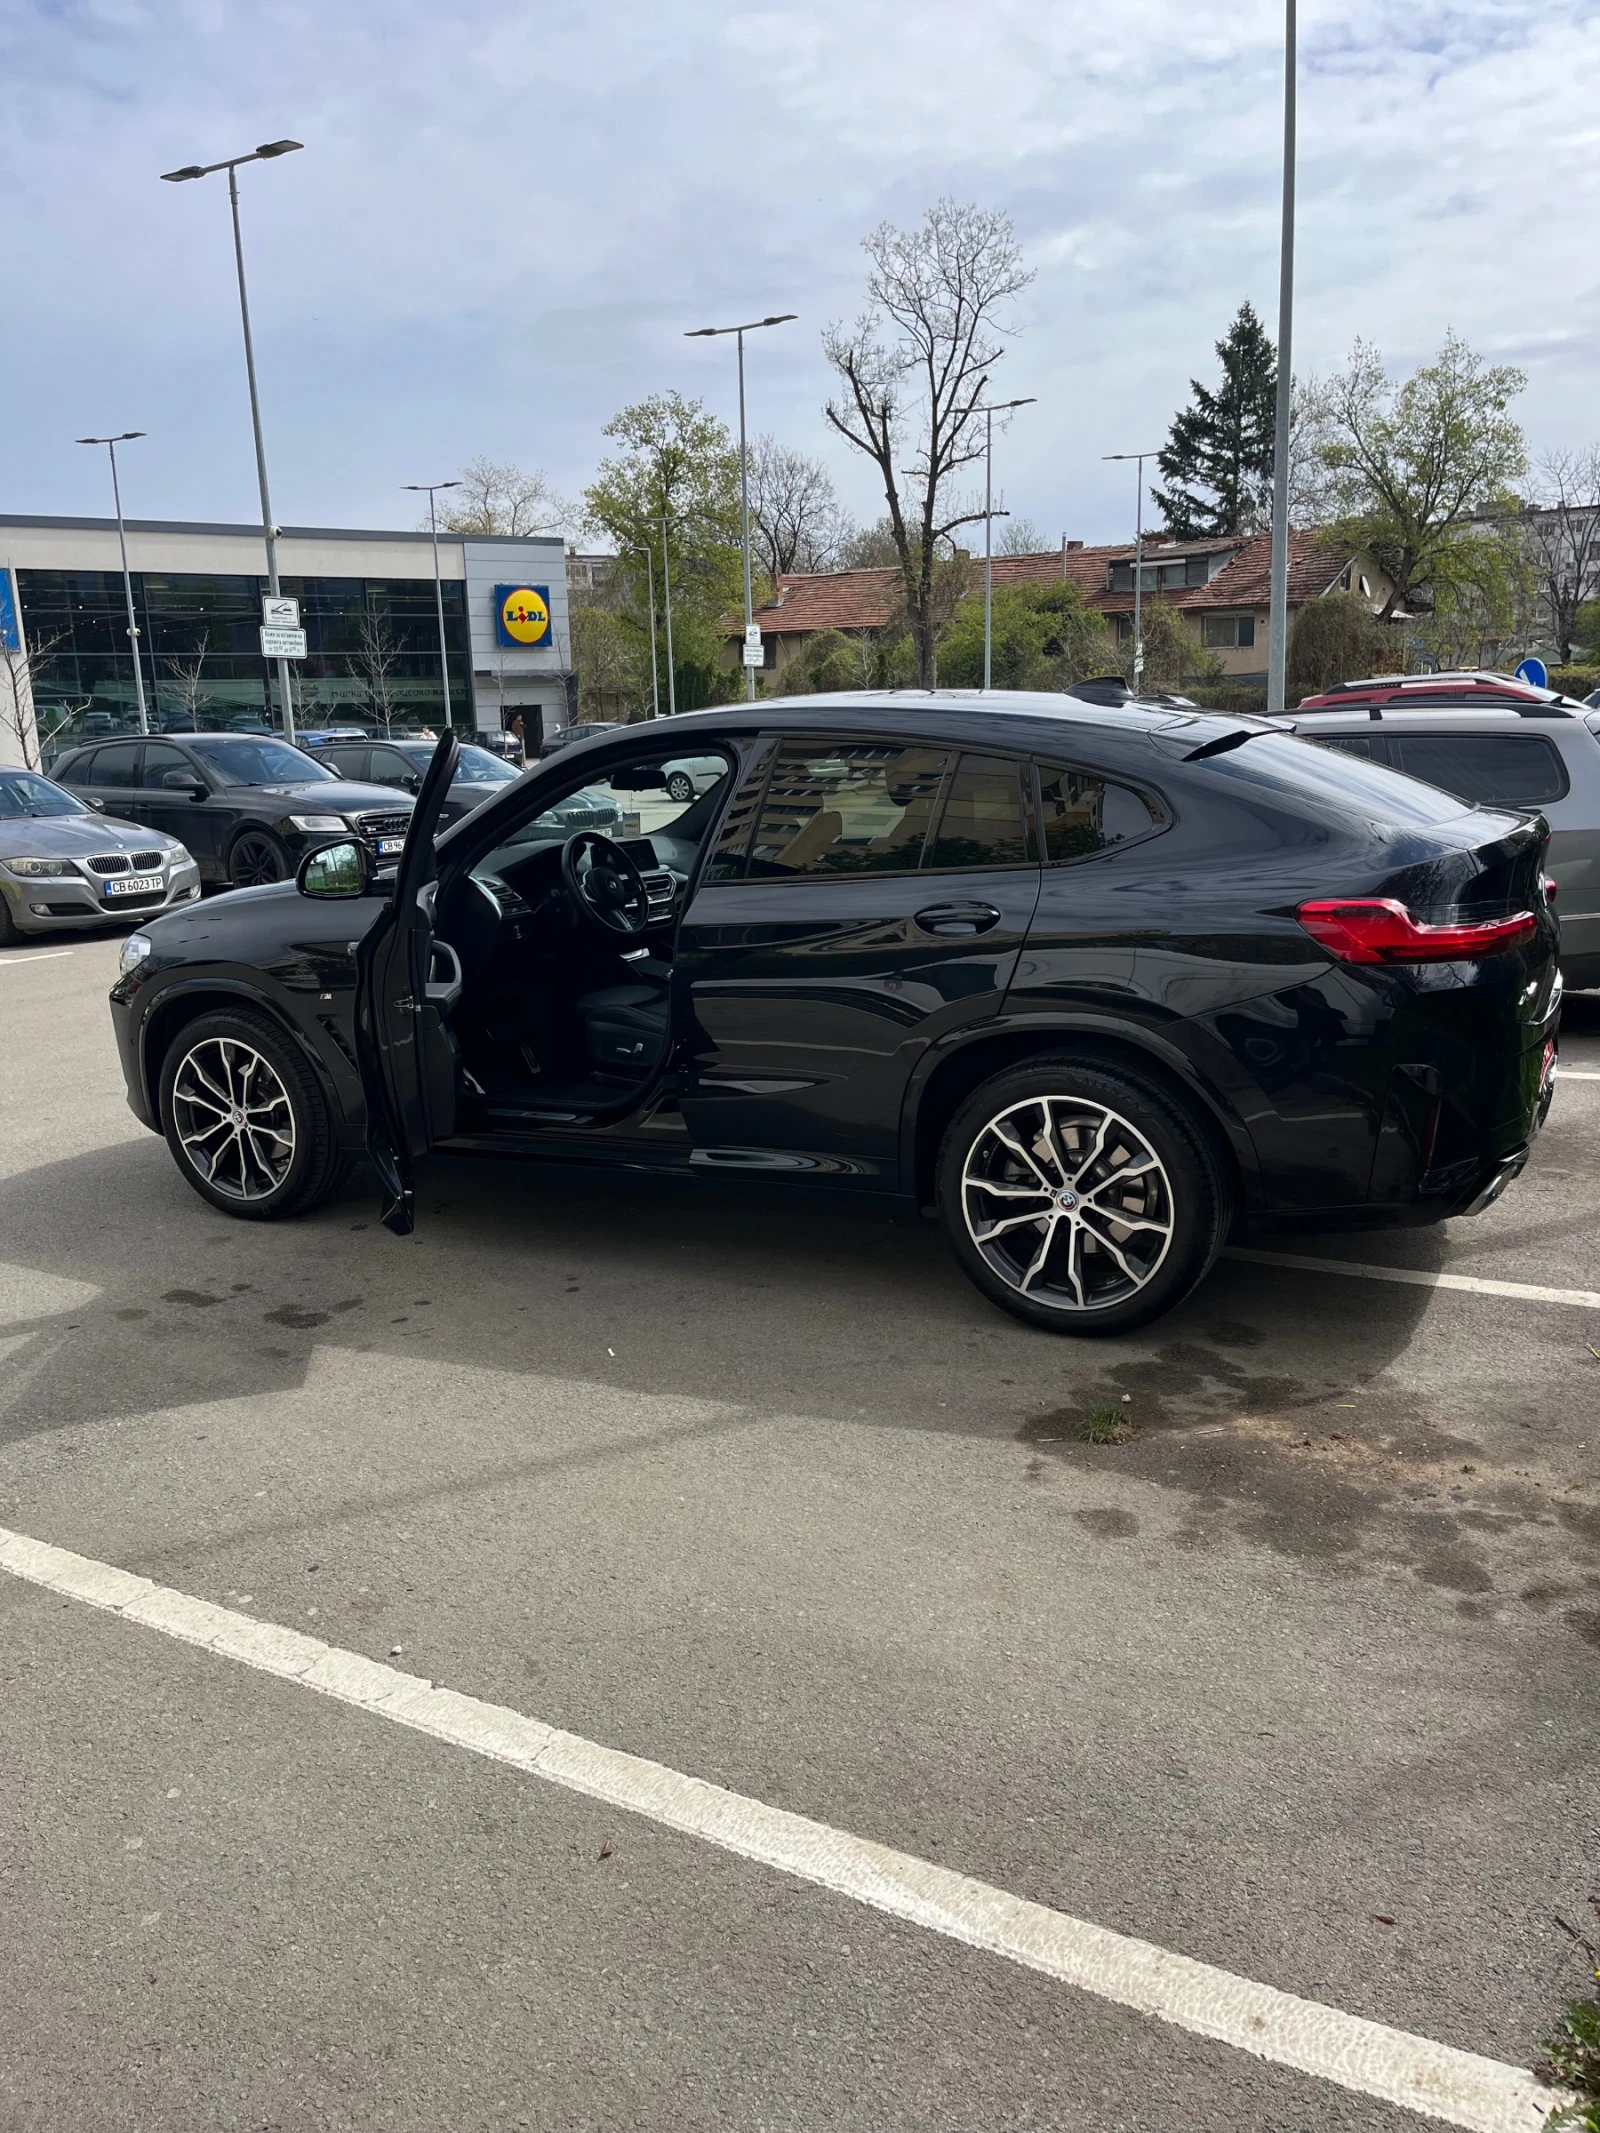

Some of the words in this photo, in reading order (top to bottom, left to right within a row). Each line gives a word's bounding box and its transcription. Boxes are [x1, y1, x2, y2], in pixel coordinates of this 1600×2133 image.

[505, 605, 546, 624] LIDL
[113, 882, 126, 892] CB
[128, 879, 149, 891] 6023
[150, 878, 161, 888] TP
